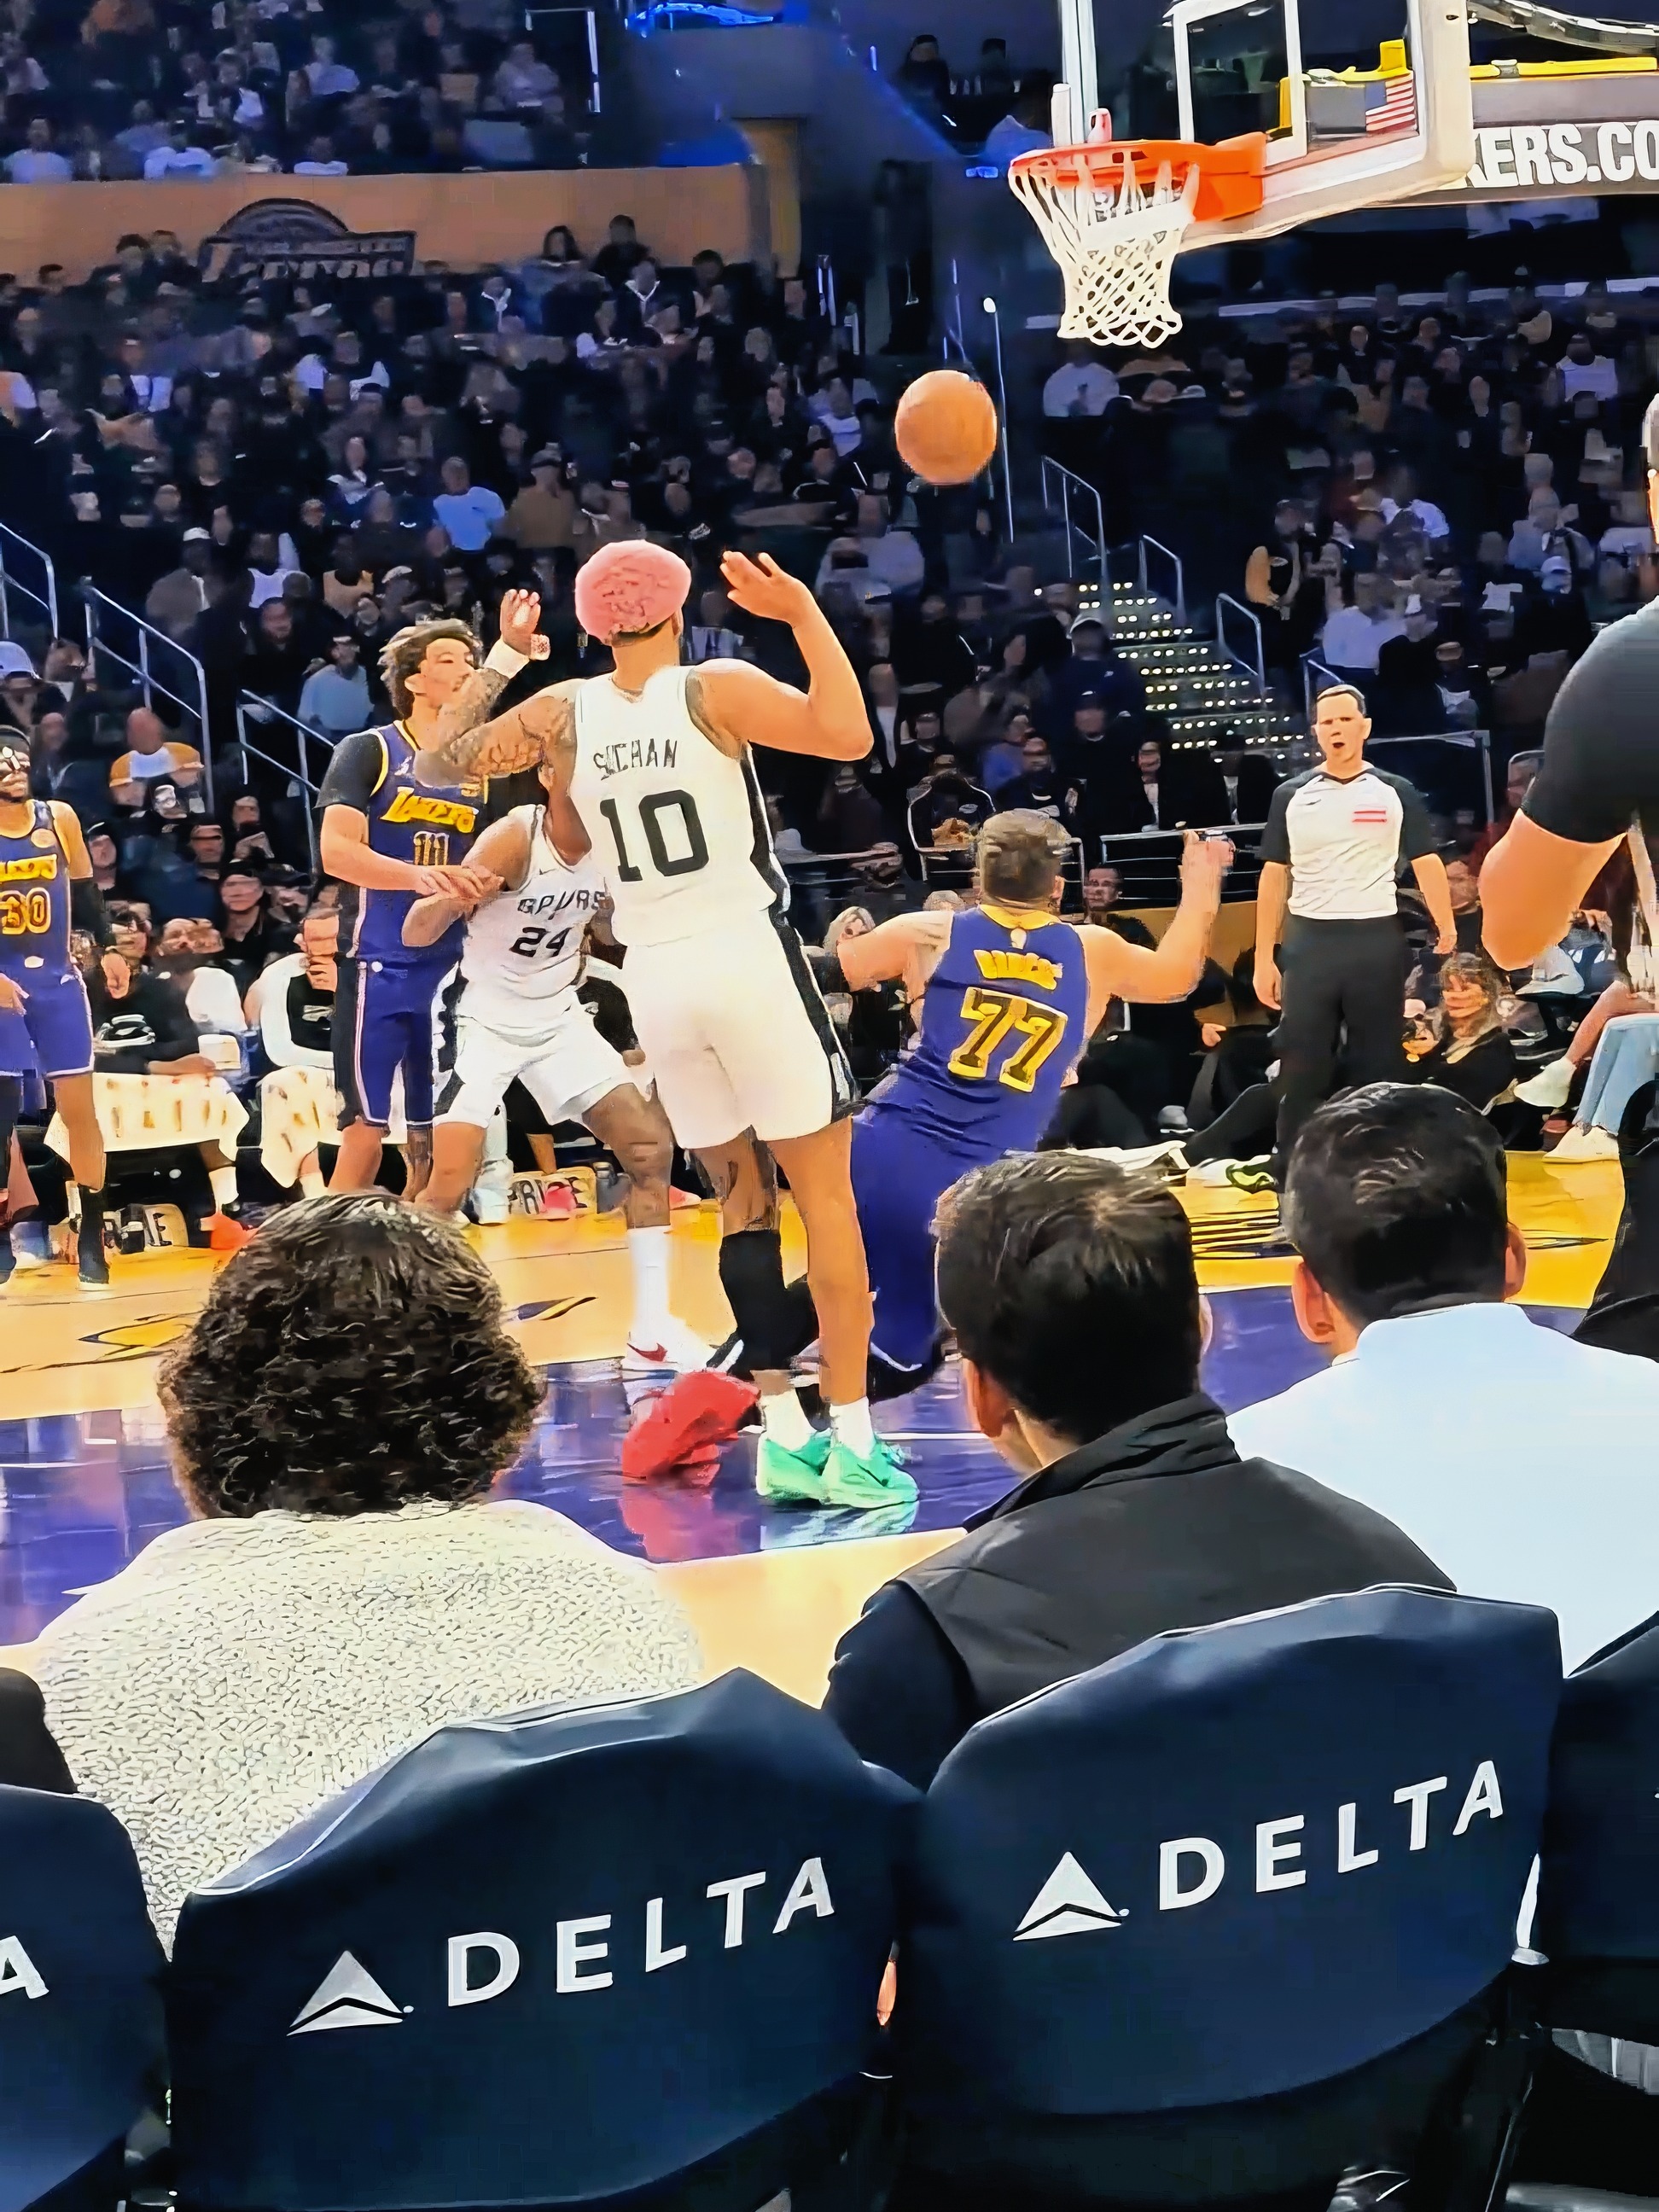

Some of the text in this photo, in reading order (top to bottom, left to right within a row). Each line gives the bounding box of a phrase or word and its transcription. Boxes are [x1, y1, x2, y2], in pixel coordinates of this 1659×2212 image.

[599, 789, 710, 882] 10
[509, 927, 573, 958] 24
[947, 987, 1068, 1092] 77
[1159, 1759, 1504, 1911] DELTA
[447, 1855, 835, 2007] DELTA
